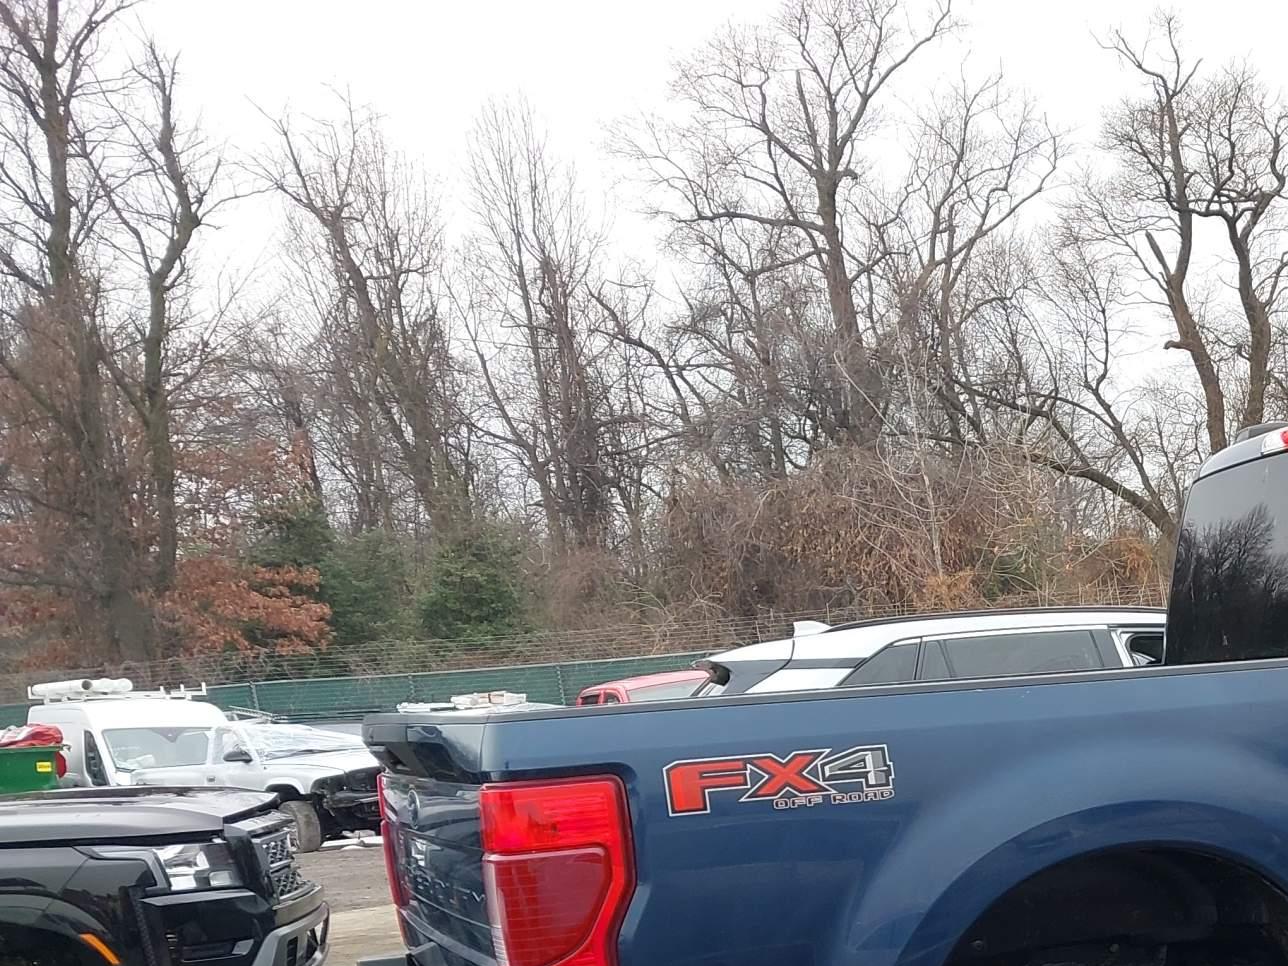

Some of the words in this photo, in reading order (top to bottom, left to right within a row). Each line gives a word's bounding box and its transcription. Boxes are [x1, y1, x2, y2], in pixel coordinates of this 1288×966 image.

[662, 743, 896, 817] FX4
[773, 795, 824, 810] OFF
[830, 788, 896, 805] ROAD
